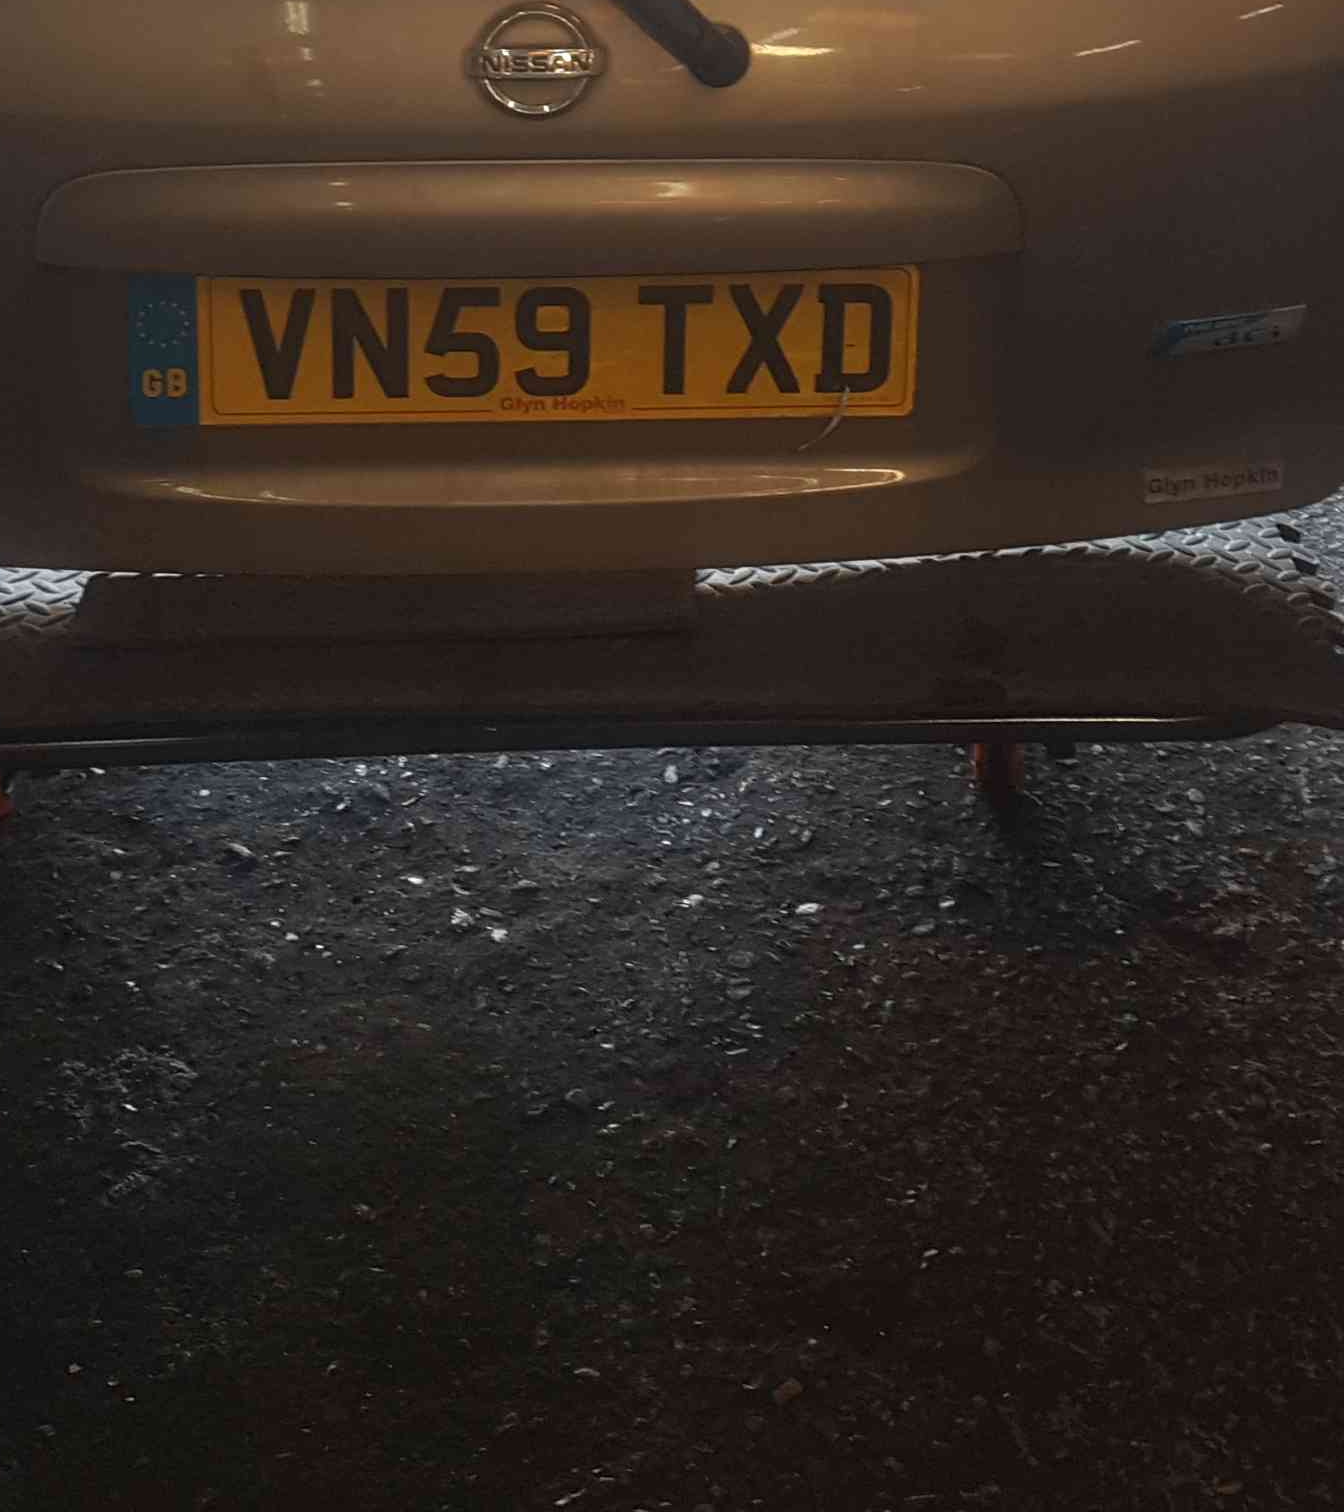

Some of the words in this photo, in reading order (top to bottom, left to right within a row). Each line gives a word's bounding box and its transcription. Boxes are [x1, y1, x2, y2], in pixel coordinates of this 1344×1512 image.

[481, 53, 594, 75] NISSAN
[239, 286, 592, 399] VN59
[638, 283, 893, 395] TXD
[142, 368, 188, 398] GB
[500, 396, 546, 414] Glyn
[553, 396, 625, 414] Hopkin
[1147, 476, 1196, 496] Glyn
[1205, 466, 1280, 491] Hopkin
